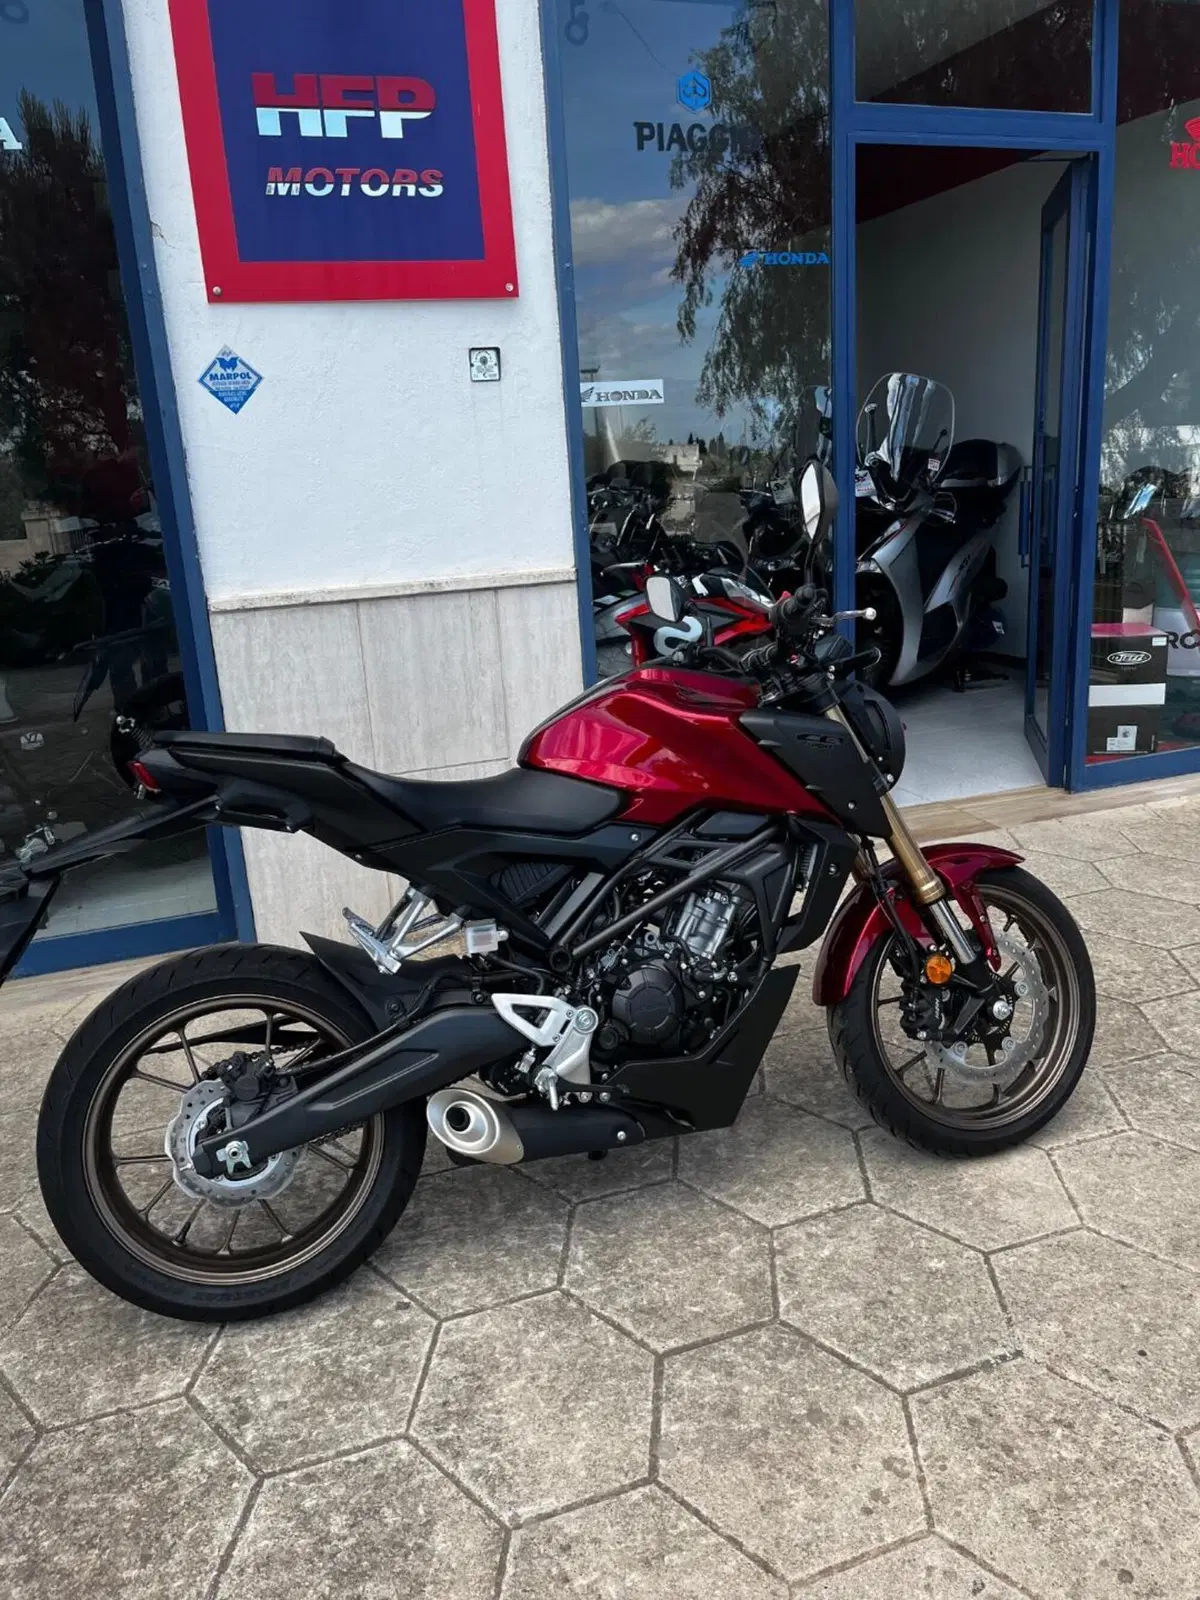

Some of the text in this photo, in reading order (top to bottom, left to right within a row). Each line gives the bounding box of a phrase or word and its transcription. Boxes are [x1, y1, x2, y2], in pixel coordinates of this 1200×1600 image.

[251, 72, 436, 138] HFP
[265, 167, 444, 197] MOTORS
[765, 252, 830, 265] HONDA
[209, 372, 252, 381] MARPOL
[595, 389, 663, 402] HONDA
